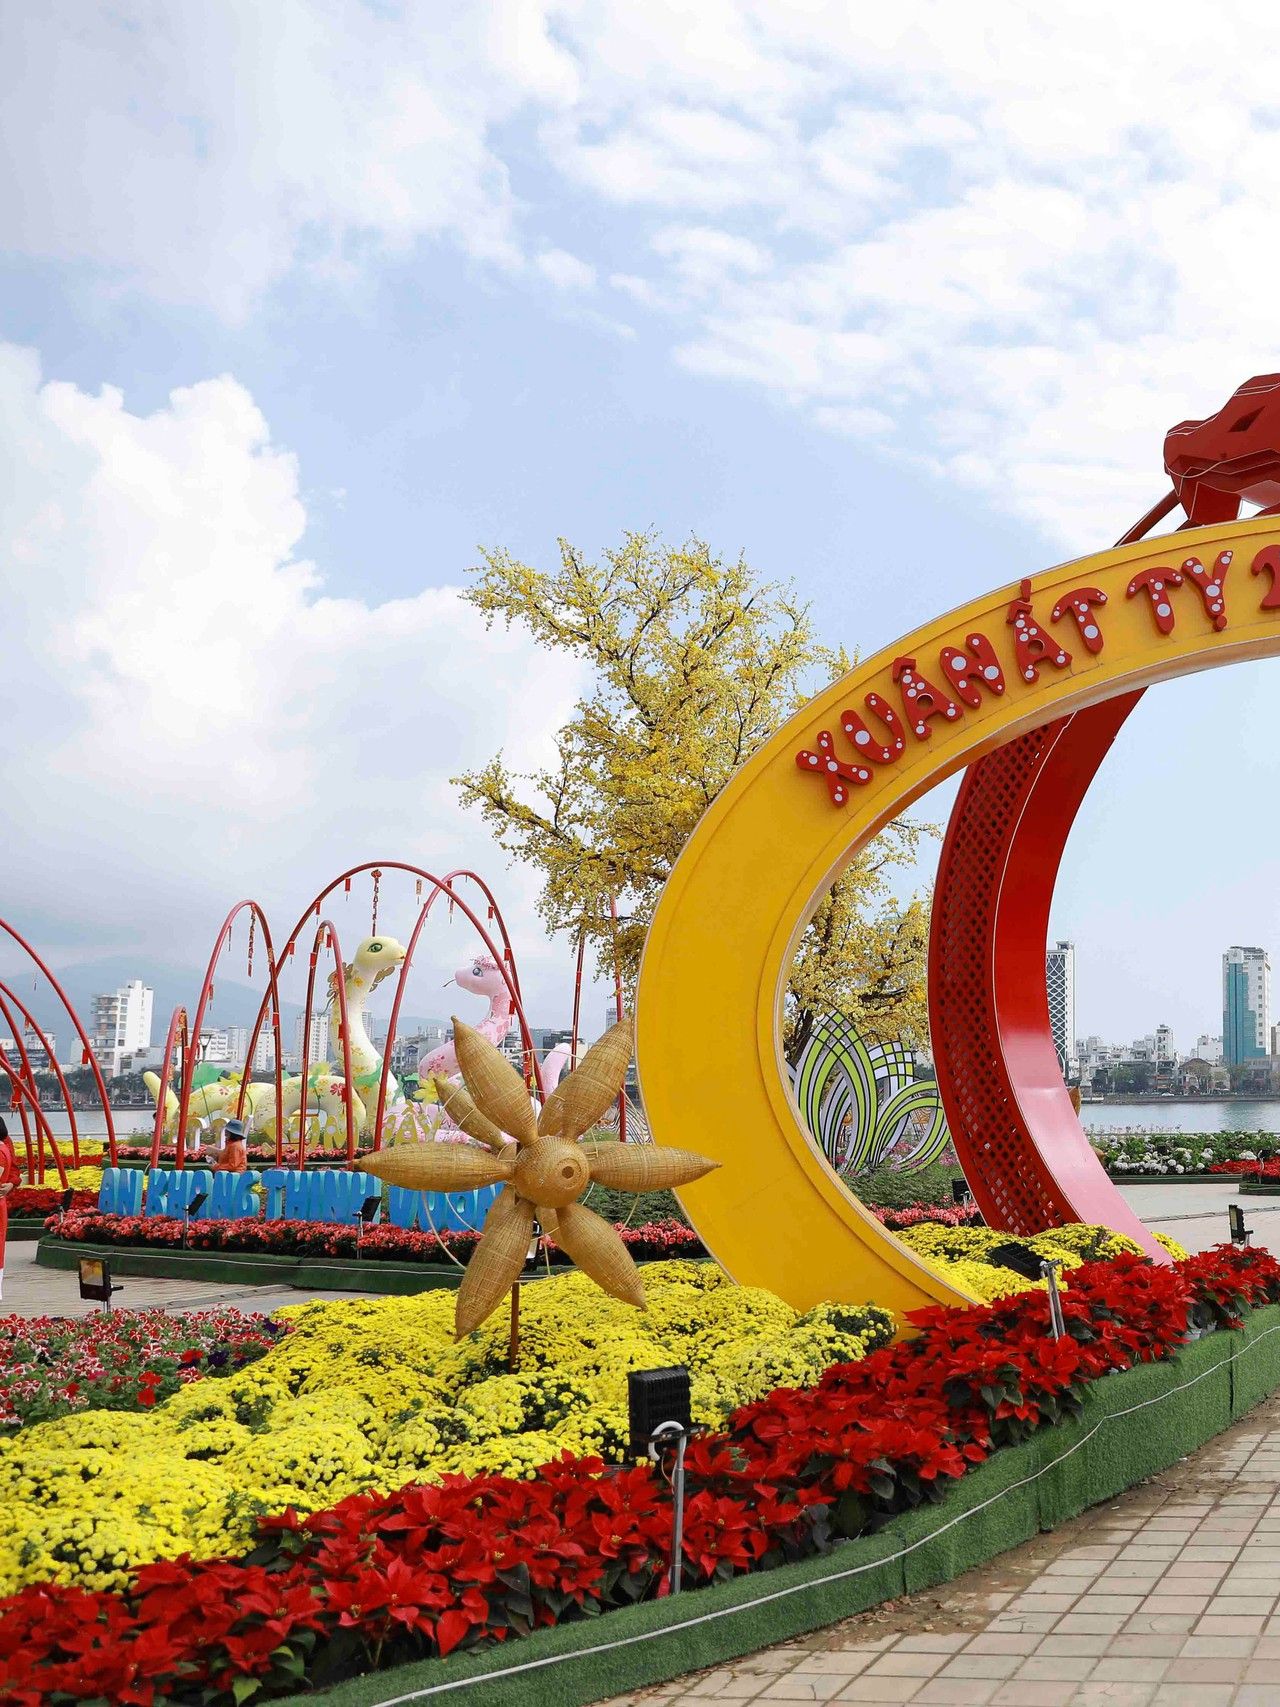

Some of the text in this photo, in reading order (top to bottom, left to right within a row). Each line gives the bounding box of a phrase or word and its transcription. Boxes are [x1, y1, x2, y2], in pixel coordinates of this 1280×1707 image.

[795, 635, 1006, 807] XUÂN
[1006, 579, 1108, 683] ẤT
[1126, 550, 1234, 632] TỴ
[98, 1167, 144, 1217] AN
[145, 1168, 261, 1221] KHANG
